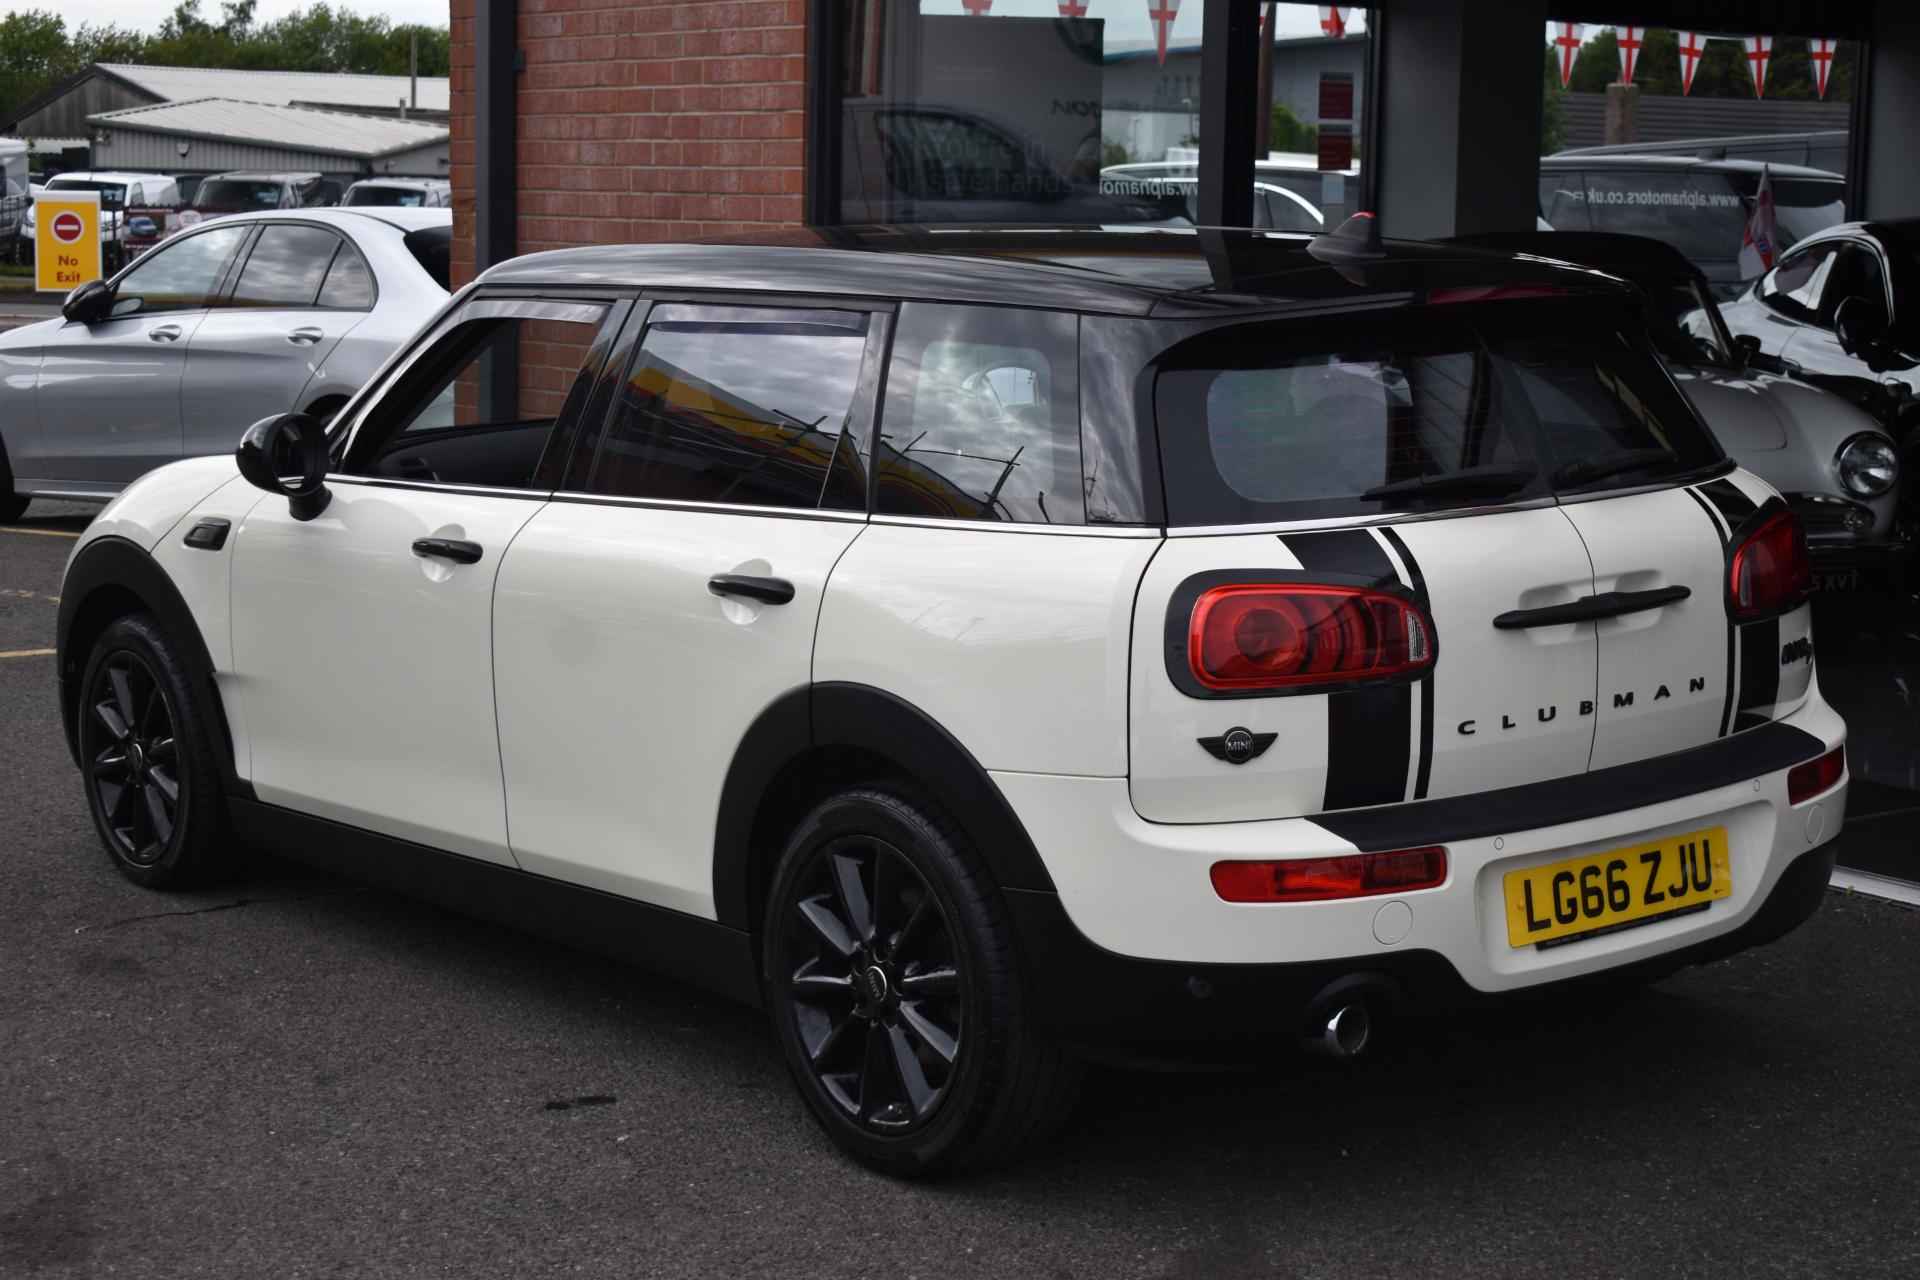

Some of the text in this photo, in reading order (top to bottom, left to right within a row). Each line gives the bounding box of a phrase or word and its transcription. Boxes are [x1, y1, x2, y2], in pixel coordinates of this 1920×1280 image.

[1674, 0, 1826, 24] MOTORS
[1024, 133, 1046, 159] in
[930, 167, 1075, 194] safe hands
[58, 255, 78, 266] No
[57, 271, 81, 283] Exit
[1825, 573, 1859, 591] XVT
[1457, 676, 1705, 736] CLUBMAN
[1227, 740, 1251, 751] MINI
[1523, 838, 1713, 933] LG66 ZJU
[868, 971, 881, 998] MINI
